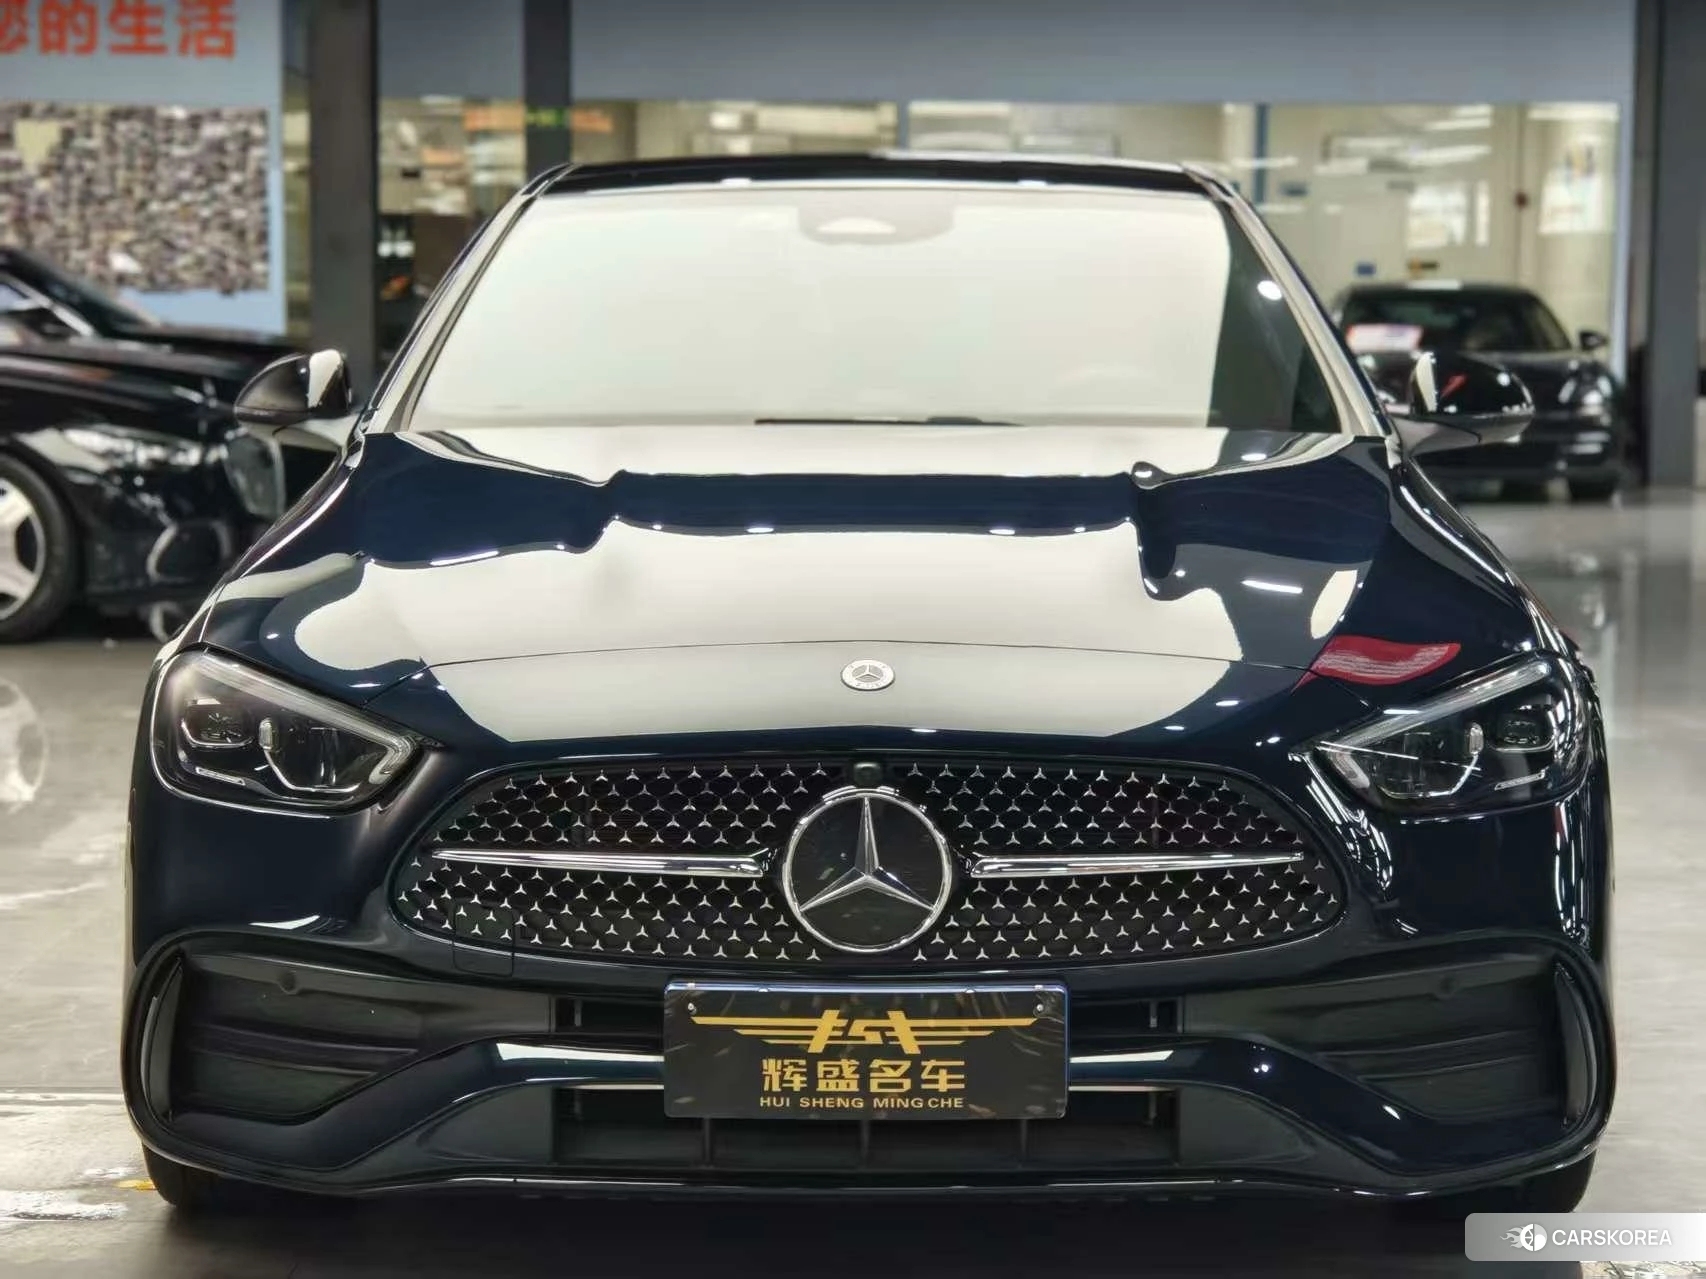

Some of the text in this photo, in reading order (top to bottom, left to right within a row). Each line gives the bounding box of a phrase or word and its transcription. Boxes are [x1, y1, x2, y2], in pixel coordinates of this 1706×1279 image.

[761, 1059, 965, 1092] 辉盛名车
[759, 1097, 790, 1108] HUI
[799, 1097, 864, 1109] SHENG
